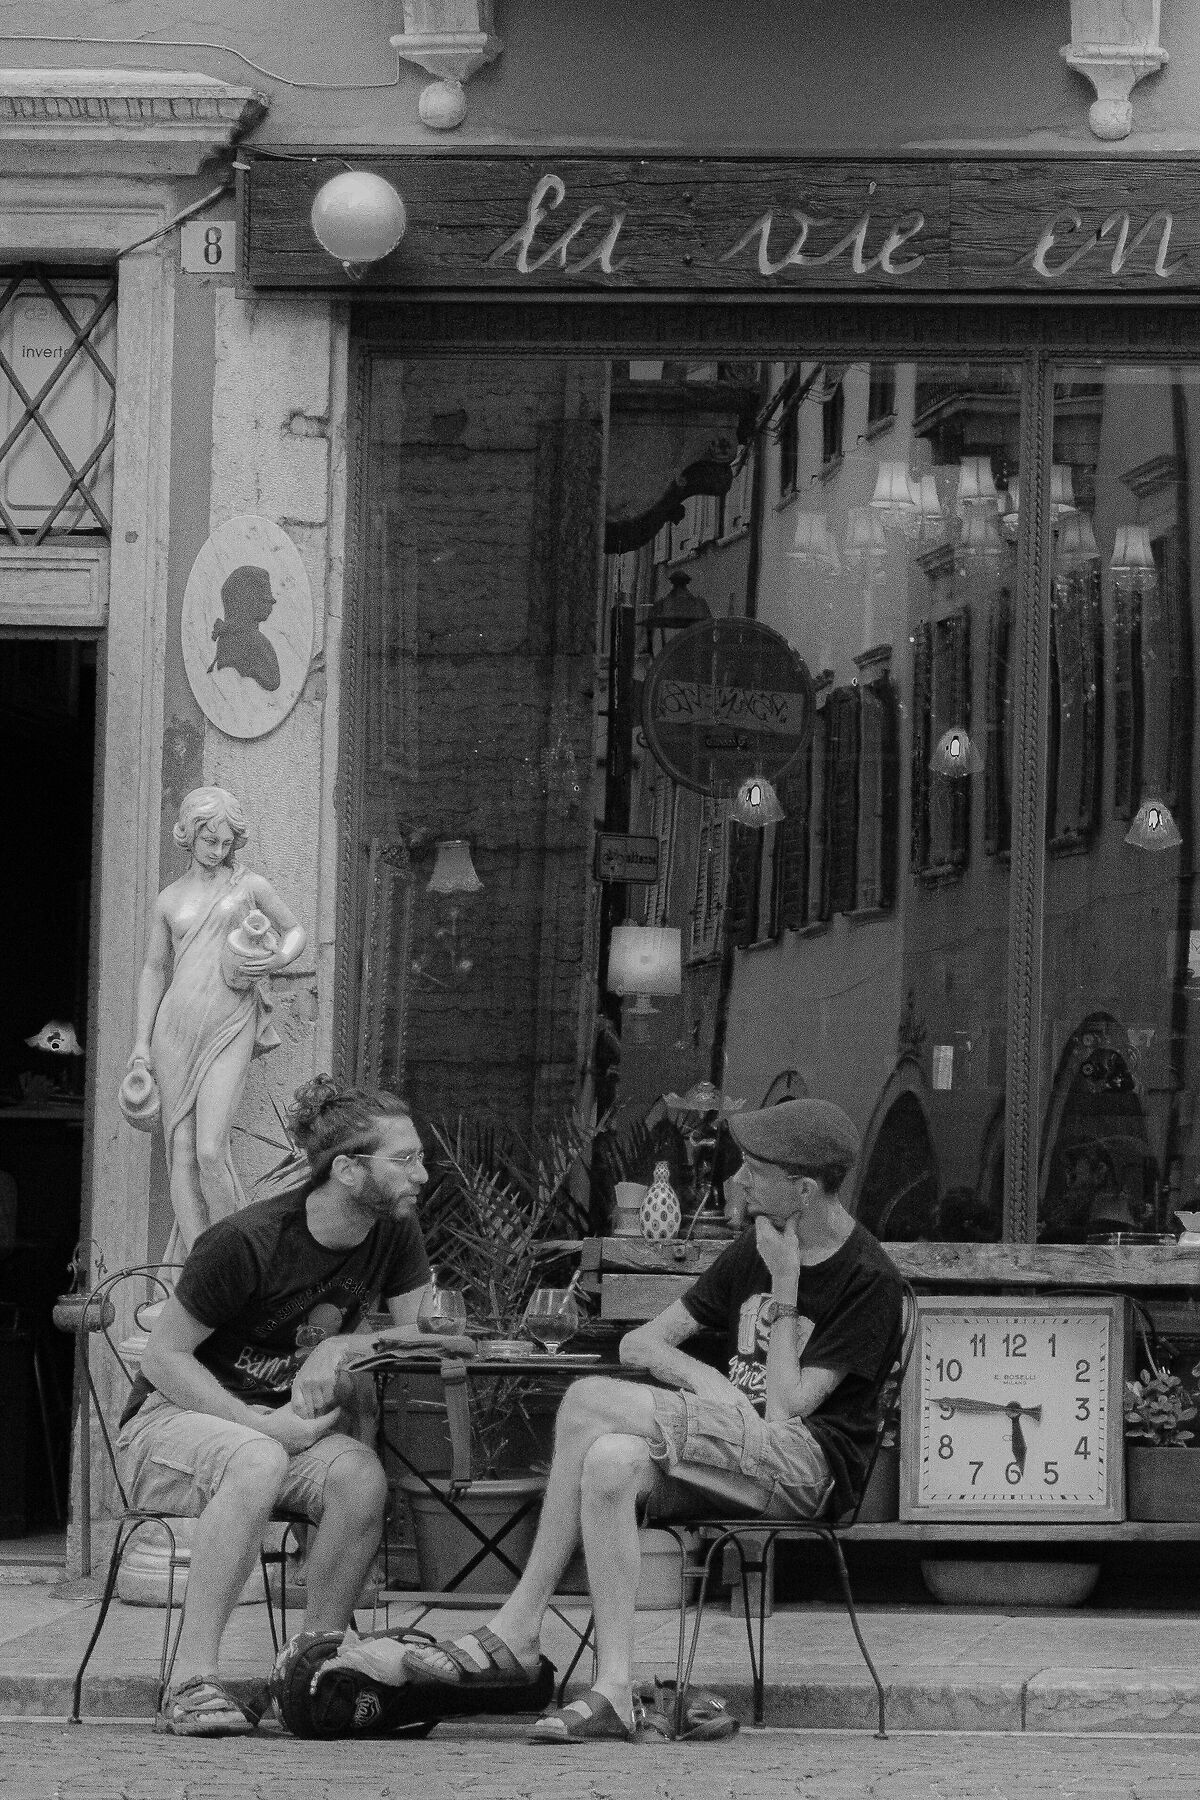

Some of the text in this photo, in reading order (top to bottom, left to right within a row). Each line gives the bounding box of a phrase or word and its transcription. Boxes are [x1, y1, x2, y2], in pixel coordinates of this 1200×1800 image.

[718, 182, 926, 275] vie
[1015, 207, 1188, 277] en
[204, 226, 222, 265] 8
[970, 1333, 1057, 1358] 11 12 1
[936, 1358, 963, 1382] 10
[1075, 1359, 1091, 1383] 2
[1075, 1397, 1091, 1422] 3
[938, 1434, 954, 1460] 8
[1074, 1436, 1091, 1460] 4
[969, 1461, 984, 1485] 7
[1005, 1461, 1022, 1485] 6
[1043, 1461, 1059, 1485] 5
